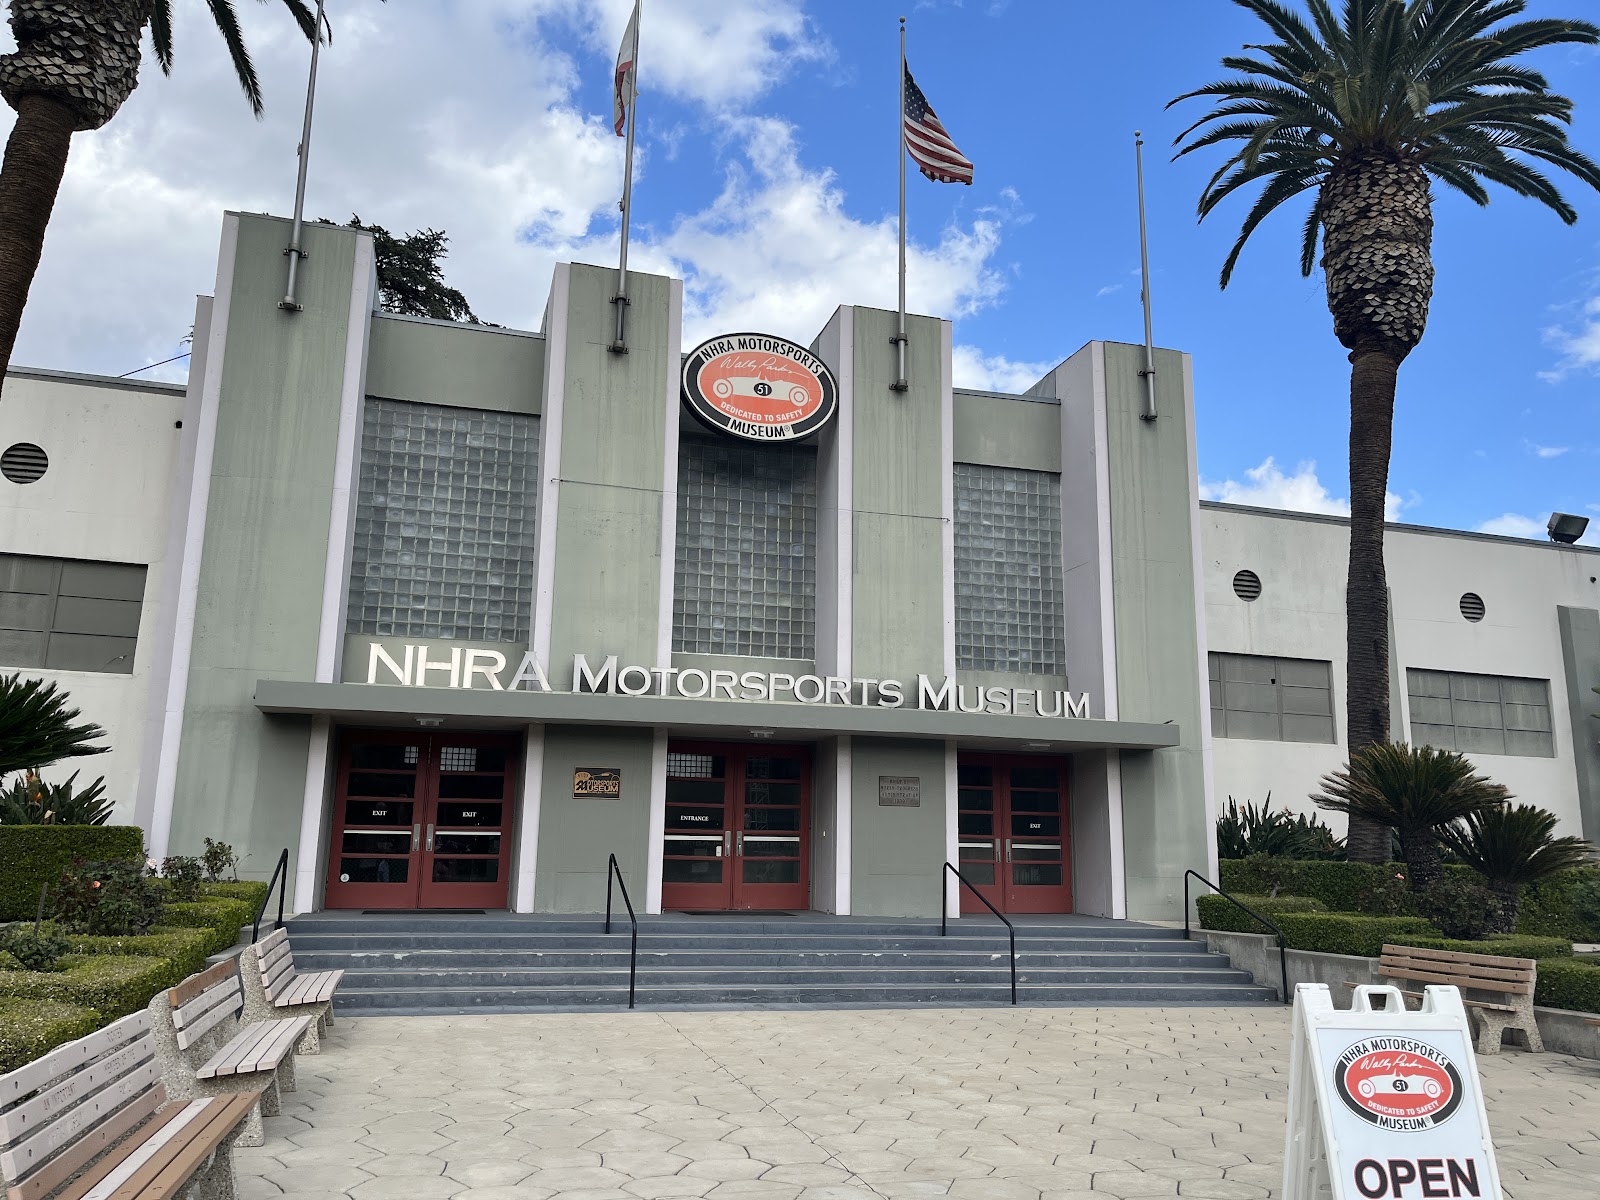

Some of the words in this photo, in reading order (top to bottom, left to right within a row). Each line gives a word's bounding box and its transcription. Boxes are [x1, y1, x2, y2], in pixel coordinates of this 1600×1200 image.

[701, 339, 735, 361] NHRA
[738, 337, 822, 375] MOTORSPORTS
[757, 384, 769, 396] 51
[720, 400, 762, 421] DEDICATED
[764, 414, 774, 422] TO
[776, 408, 804, 422] SAFETY
[366, 642, 553, 692] NHRA
[571, 653, 905, 708] MOTORSPORTS
[916, 673, 1091, 719] MUSEUM
[680, 814, 709, 822] ENTRANCE
[1342, 1042, 1370, 1065] NHRA
[1371, 1038, 1448, 1067] MOTORSPORTS
[1395, 1080, 1406, 1091] 51
[1367, 1099, 1405, 1116] DEDICATED
[1406, 1108, 1415, 1116] TO
[1416, 1099, 1440, 1116] SAFETY
[1354, 1158, 1480, 1200] OPEN
